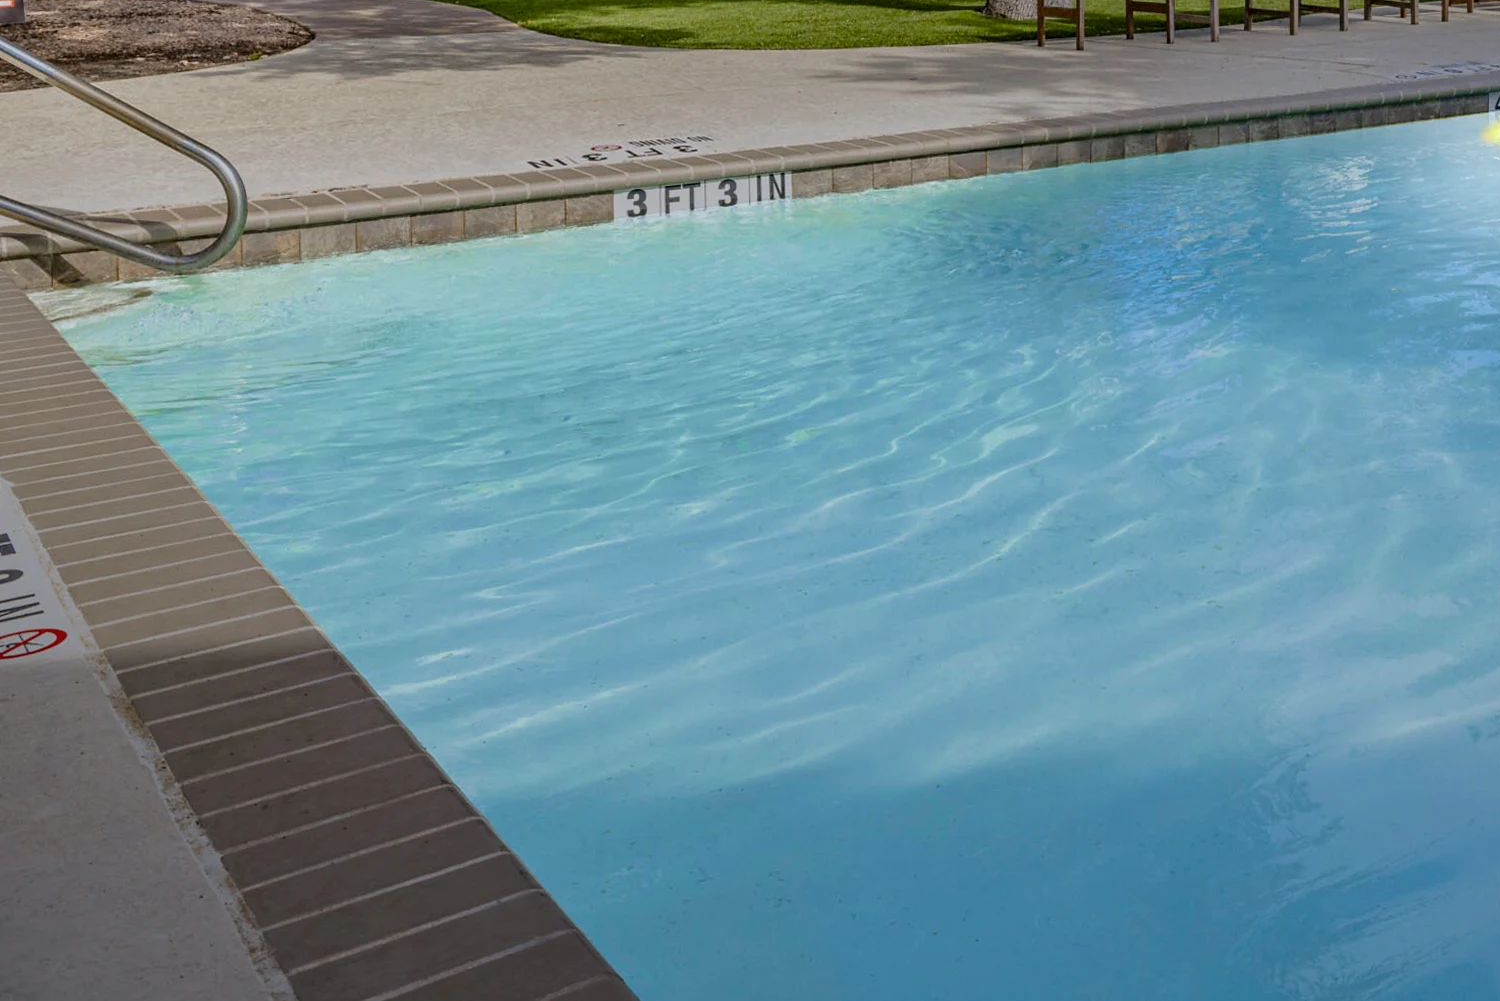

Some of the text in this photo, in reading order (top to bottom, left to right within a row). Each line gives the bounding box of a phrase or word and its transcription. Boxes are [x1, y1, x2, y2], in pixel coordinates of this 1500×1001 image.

[527, 145, 699, 169] 3 FT 3 IN
[626, 172, 786, 218] 3 FT 3 IN
